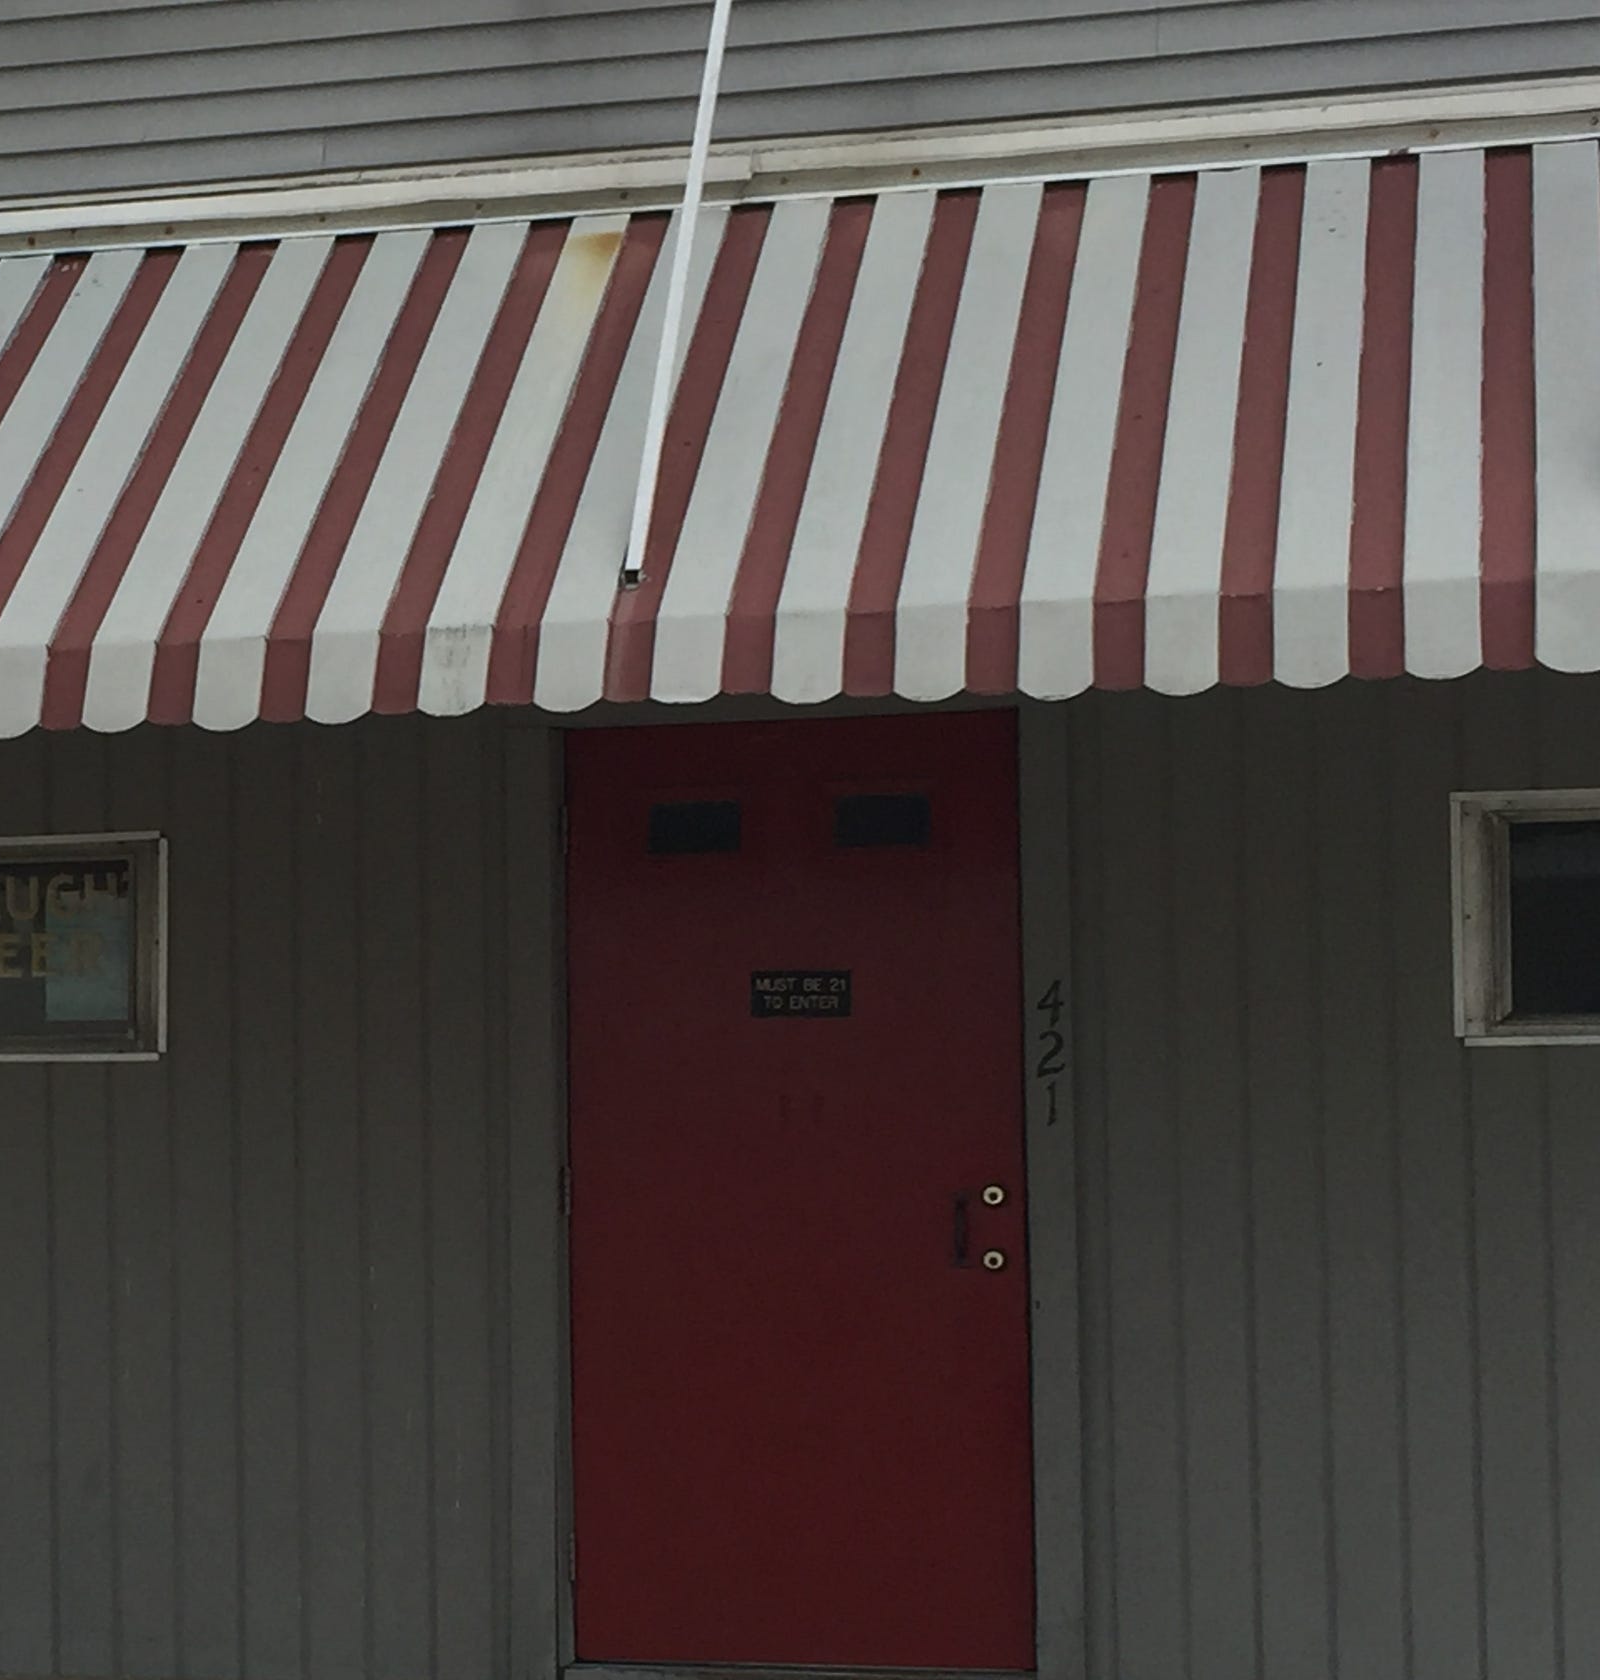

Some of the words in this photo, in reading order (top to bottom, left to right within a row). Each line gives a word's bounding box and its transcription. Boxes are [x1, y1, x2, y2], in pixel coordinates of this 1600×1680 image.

[755, 976, 798, 992] MUST
[802, 976, 823, 992] BE
[829, 976, 847, 992] 21
[763, 994, 784, 1009] TO
[789, 994, 839, 1010] ENTER
